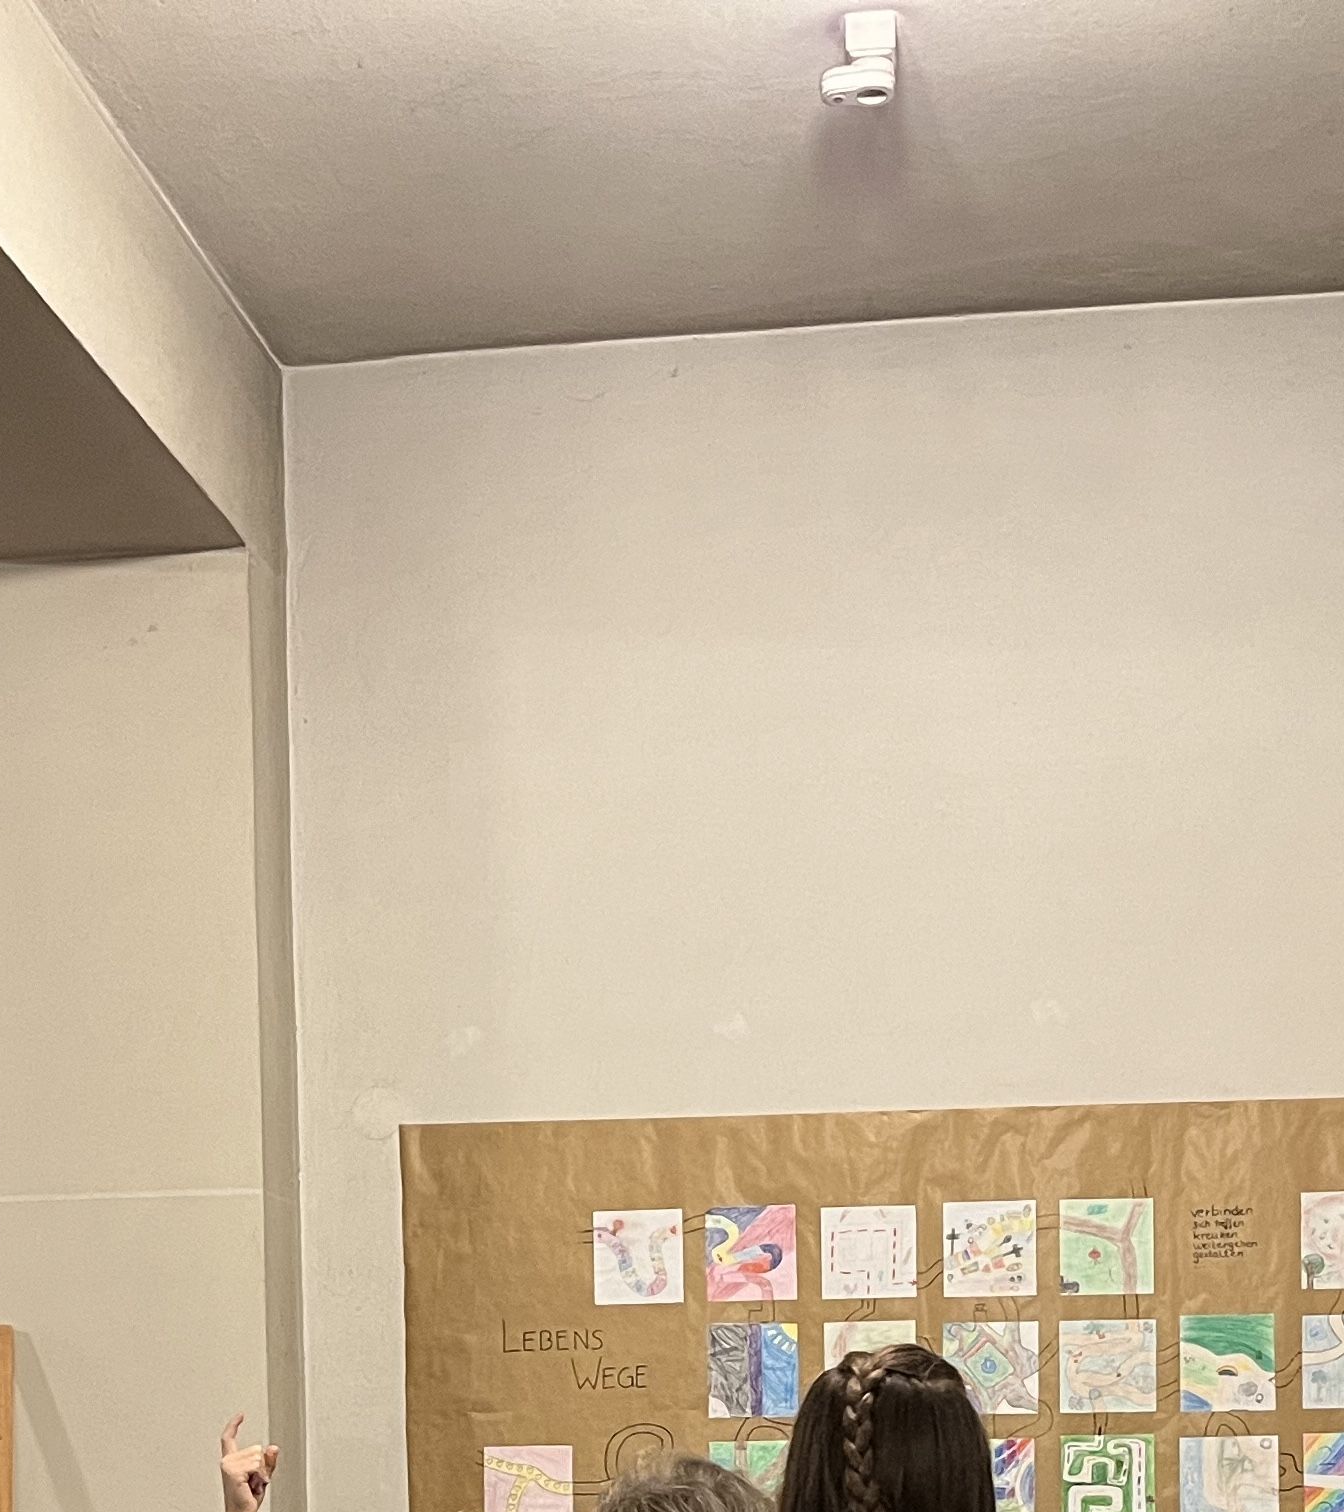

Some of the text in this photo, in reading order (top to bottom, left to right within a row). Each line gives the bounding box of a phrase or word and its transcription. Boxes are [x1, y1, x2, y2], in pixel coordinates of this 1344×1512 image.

[1190, 1203, 1254, 1218] verbinden
[502, 1317, 605, 1354] LEBENS
[570, 1355, 649, 1390] WEGE
